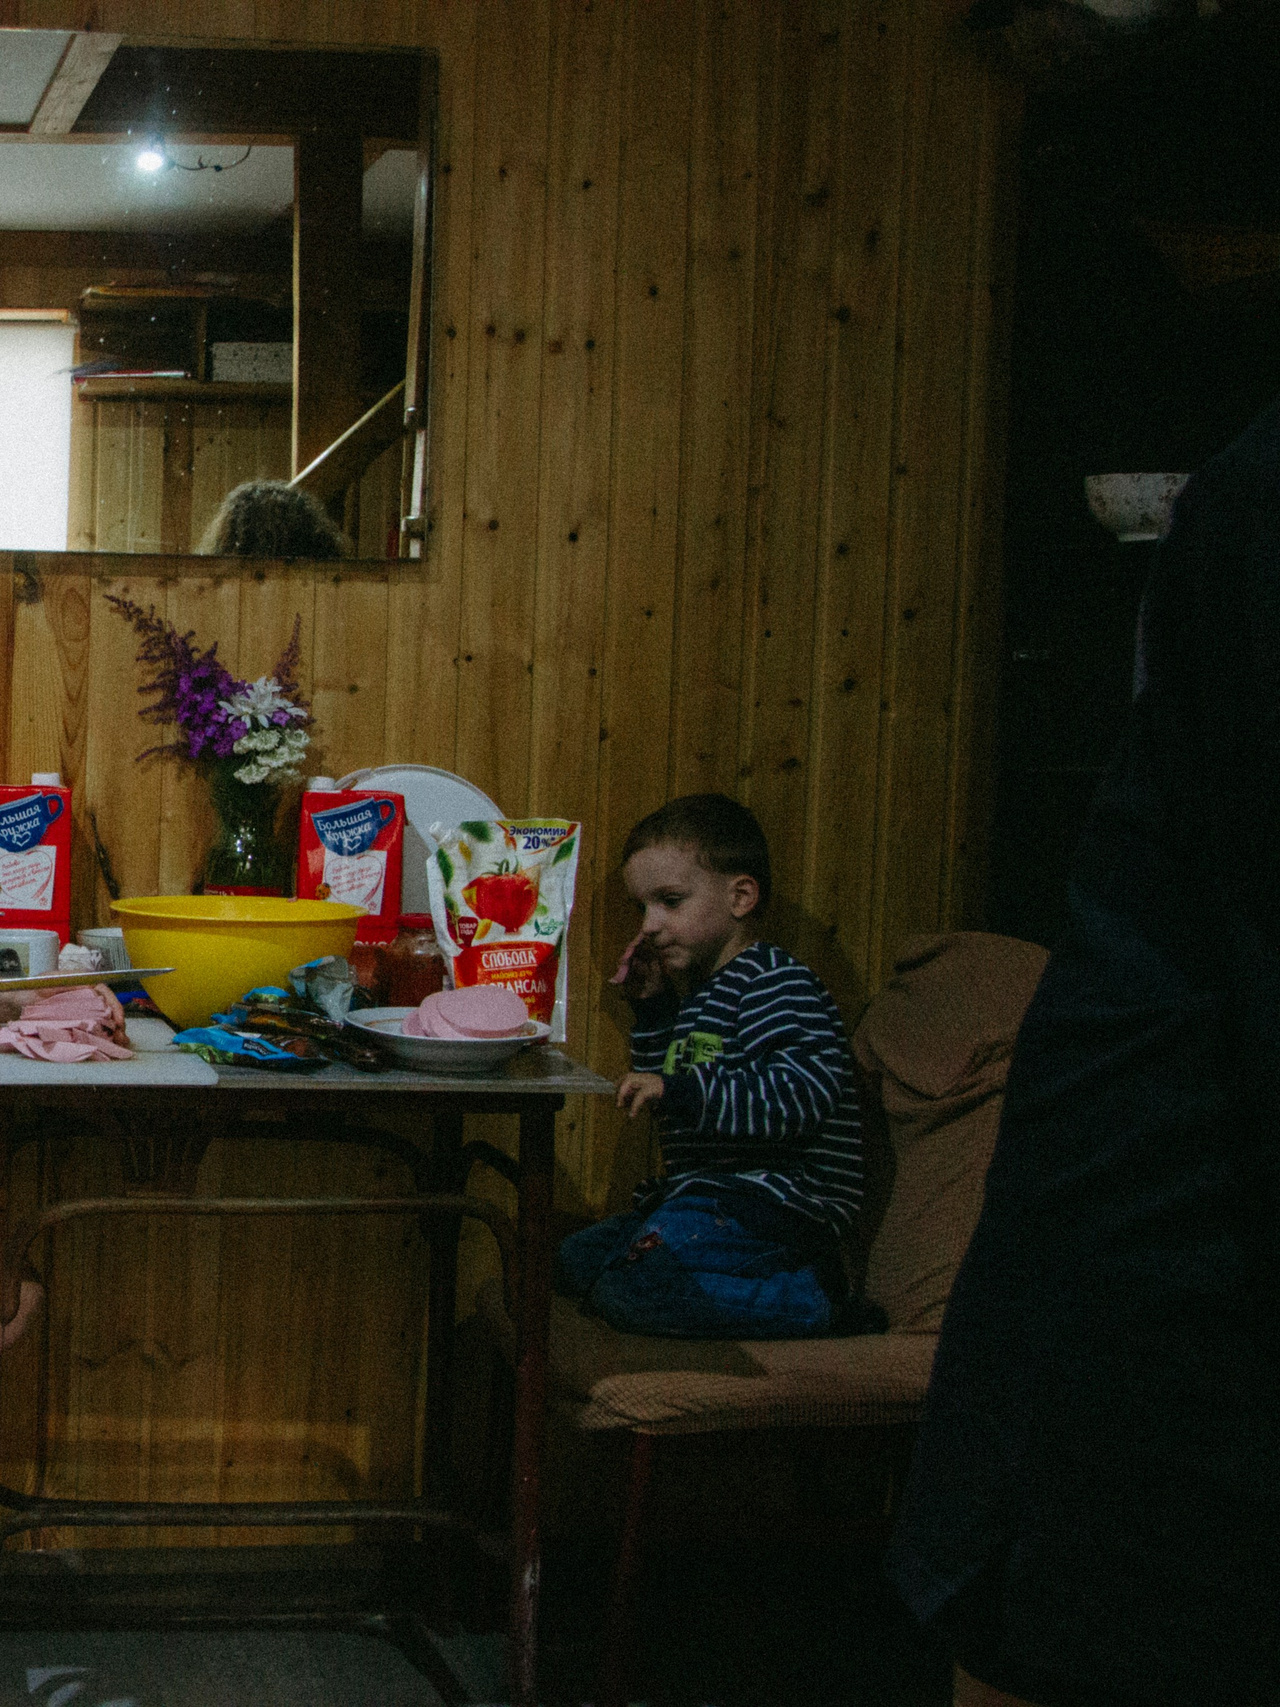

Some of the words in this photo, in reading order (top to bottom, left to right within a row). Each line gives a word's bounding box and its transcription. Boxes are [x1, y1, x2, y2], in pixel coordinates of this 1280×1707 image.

[317, 809, 373, 832] Большая
[324, 822, 371, 847] Кружка
[508, 826, 567, 837] Экономия
[481, 950, 537, 969] СЛОБОДА
